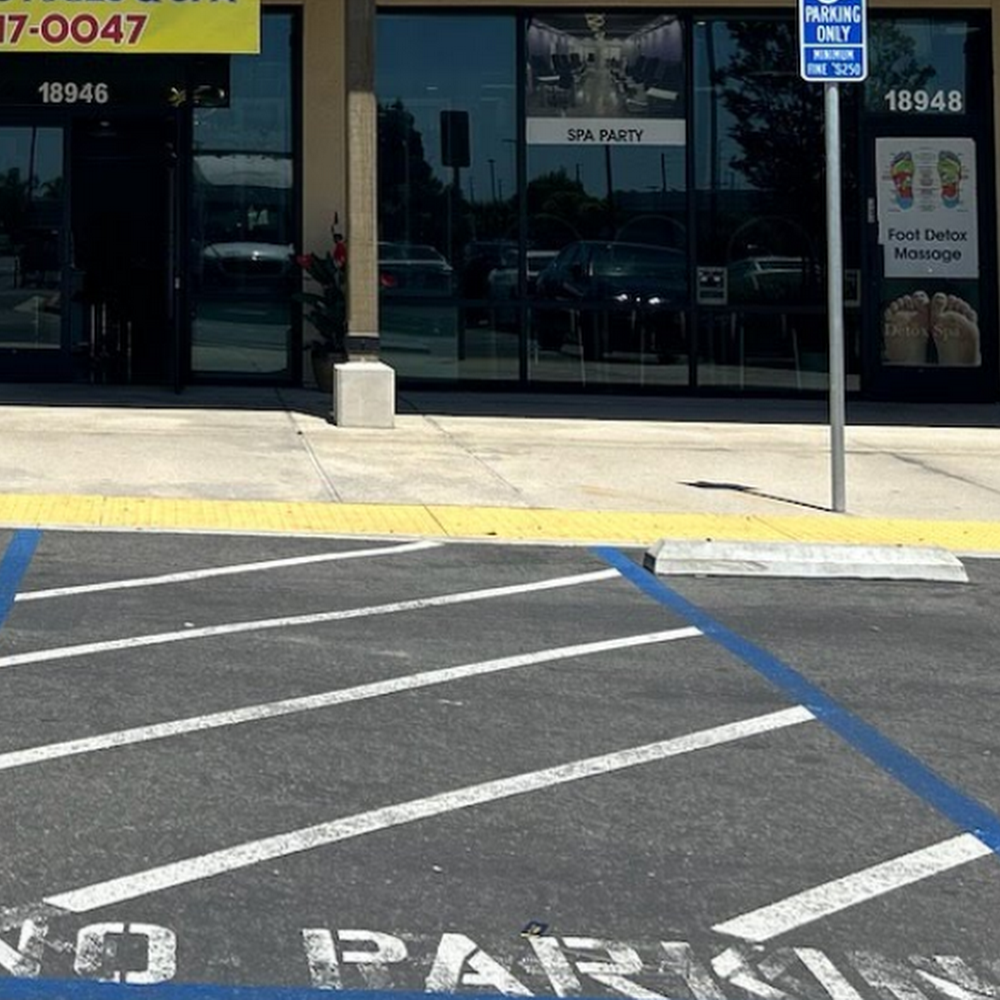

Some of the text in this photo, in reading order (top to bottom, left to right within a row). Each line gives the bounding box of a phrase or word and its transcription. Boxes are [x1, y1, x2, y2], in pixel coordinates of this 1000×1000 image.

[805, 5, 861, 23] PARKING
[816, 25, 851, 43] ONLY
[38, 82, 109, 104] 18946
[884, 90, 963, 112] 18948
[567, 129, 645, 143] SPA PARTY
[888, 229, 967, 242] Foot Detox
[894, 248, 962, 263] Massage
